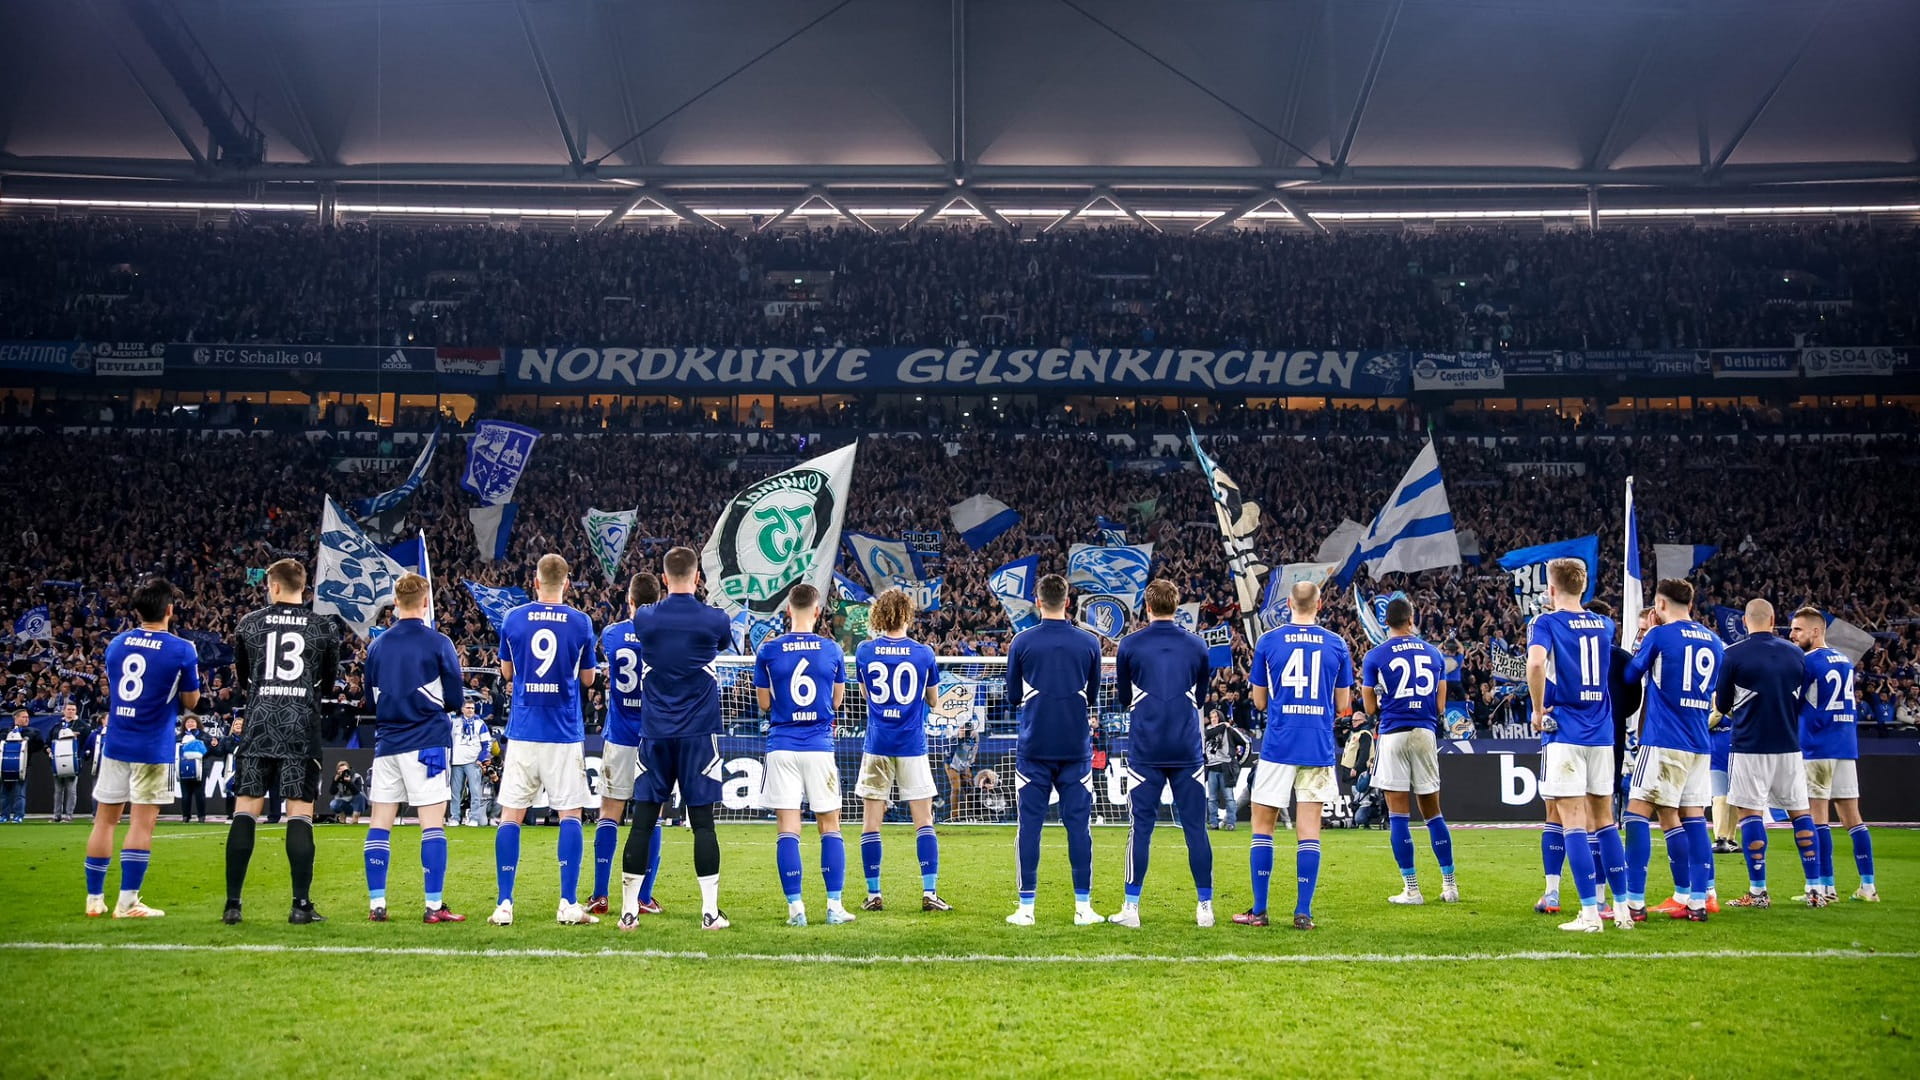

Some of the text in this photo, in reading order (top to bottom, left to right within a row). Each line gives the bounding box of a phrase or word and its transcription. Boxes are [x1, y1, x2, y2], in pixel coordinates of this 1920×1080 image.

[215, 350, 323, 364] FC Schalke 04
[1724, 354, 1787, 368] Delbrück
[518, 348, 1359, 390] NORDKURVE GELSENKIRCHEN
[1440, 371, 1479, 381] Coesfeld
[903, 533, 938, 544] SUPER
[266, 615, 308, 626] SCHALKE
[528, 612, 568, 622] SCHALKE
[1568, 620, 1604, 629] SCHALKE
[1284, 634, 1324, 644] SCHALKE
[1680, 629, 1712, 642] SCHALKE
[124, 636, 162, 650] SCHALKE
[782, 642, 822, 652] SCHALKE
[1392, 643, 1424, 653] SCHALKE
[264, 631, 306, 681] 13
[530, 628, 558, 678] 9
[875, 646, 912, 656] SCHALKE
[1579, 636, 1600, 686] 11
[1281, 648, 1322, 700] 41
[1682, 645, 1715, 694] 19
[118, 653, 146, 702] 8
[790, 657, 816, 707] 6
[868, 661, 918, 706] 30
[1388, 655, 1434, 700] 25
[259, 686, 306, 697] SCHWOLOW
[525, 682, 560, 693] TERODDE
[1825, 669, 1856, 711] 24
[116, 706, 136, 718] LATZA
[1282, 704, 1324, 716] MATRICIANI
